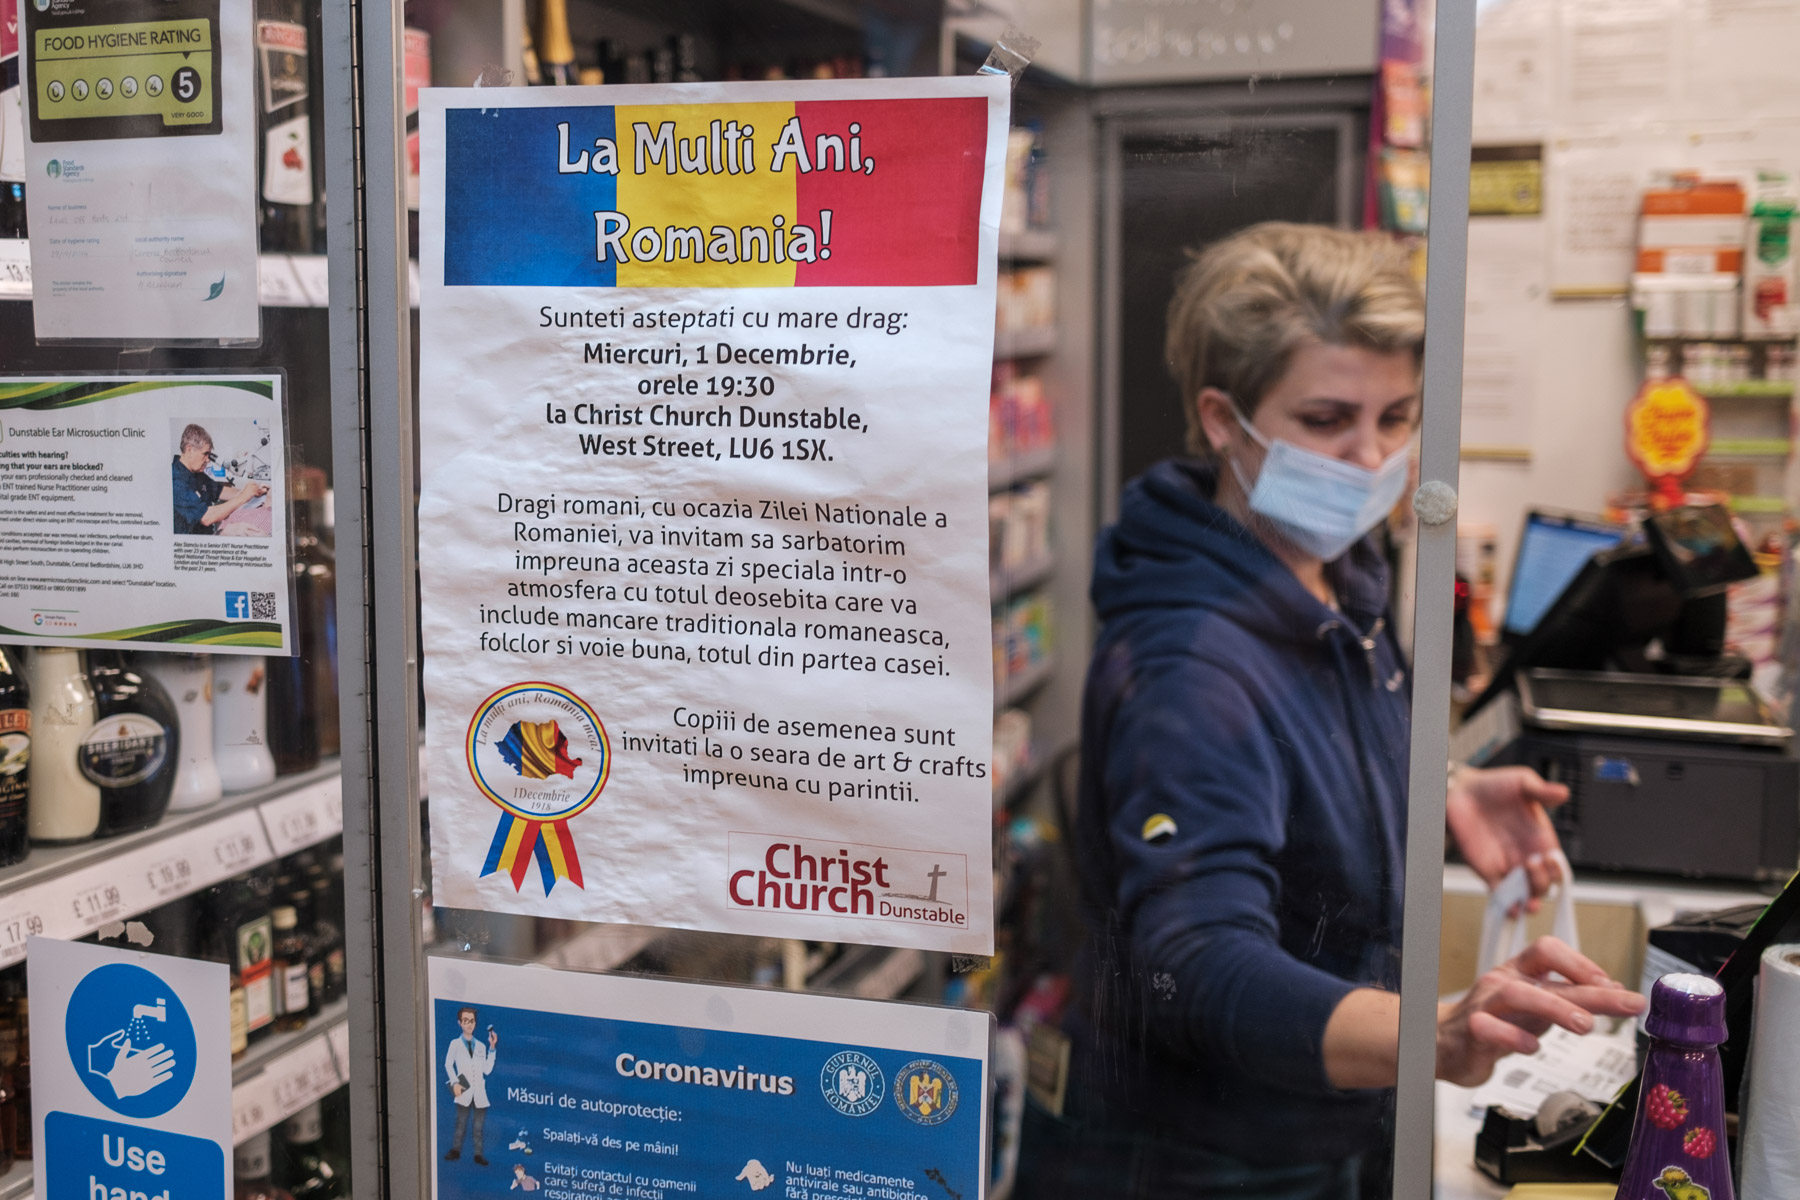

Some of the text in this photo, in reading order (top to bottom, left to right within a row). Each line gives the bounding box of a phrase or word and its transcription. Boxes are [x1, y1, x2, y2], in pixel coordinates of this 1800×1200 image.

[44, 28, 201, 51] FOOD HYGIENE RATING
[178, 71, 195, 99] 5
[556, 117, 876, 176] La Multi Ani,
[593, 209, 833, 264] Romania!
[540, 306, 908, 335] Sunteti asteptati cu mare drag:
[584, 343, 856, 368] Miercuri, 1 Decembrie,
[638, 374, 774, 397] orele 19:30
[547, 403, 868, 433] la Christ Church Dunstable,
[9, 427, 145, 438] Dunstable Ear Microsuction Clinic
[38, 451, 69, 460] hearing?
[579, 434, 833, 461] West Street, LU6 1SX.
[28, 473, 69, 482] professionally
[72, 463, 104, 471] blocked?
[10, 494, 27, 502] grade
[15, 483, 36, 491] trained
[91, 485, 108, 493] using
[499, 493, 946, 528] Dragi romani, cu ocazia Zilei Nationale a
[515, 522, 905, 555] Romaniei, va invitam sa sarbatorim
[516, 550, 906, 584] impreuna aceasta zi speciala intr-o
[508, 579, 916, 614] atmosfera cu totul deosebita care va
[480, 604, 949, 649] include mancare traditionala romaneasca,
[480, 632, 949, 676] folclor si voie buna, totul din partea casei.
[674, 707, 955, 746] Copiii de asemenea sunt
[622, 731, 986, 778] invitati la o seara de art & crafts
[683, 764, 918, 802] impreuna cu parintii.
[531, 801, 551, 811] 1918
[764, 842, 890, 889] Christ
[728, 868, 875, 916] Church
[879, 901, 966, 925] Dunstable
[615, 1052, 795, 1096] Coronavirus
[826, 1053, 879, 1080] GUVERNUL
[508, 1087, 553, 1105] Măsuri
[559, 1094, 576, 1108] de
[103, 1134, 165, 1175] Use
[602, 1136, 622, 1148] des
[626, 1141, 640, 1152] pe
[545, 1177, 568, 1187] care
[609, 1184, 623, 1195] de
[581, 1169, 631, 1183] contactul
[635, 1176, 648, 1186] cu
[652, 1178, 696, 1191] oamenii
[786, 1161, 802, 1173] Nu
[835, 1170, 914, 1189] medicamente
[786, 1176, 839, 1191] antivirale
[843, 1184, 862, 1195] sau
